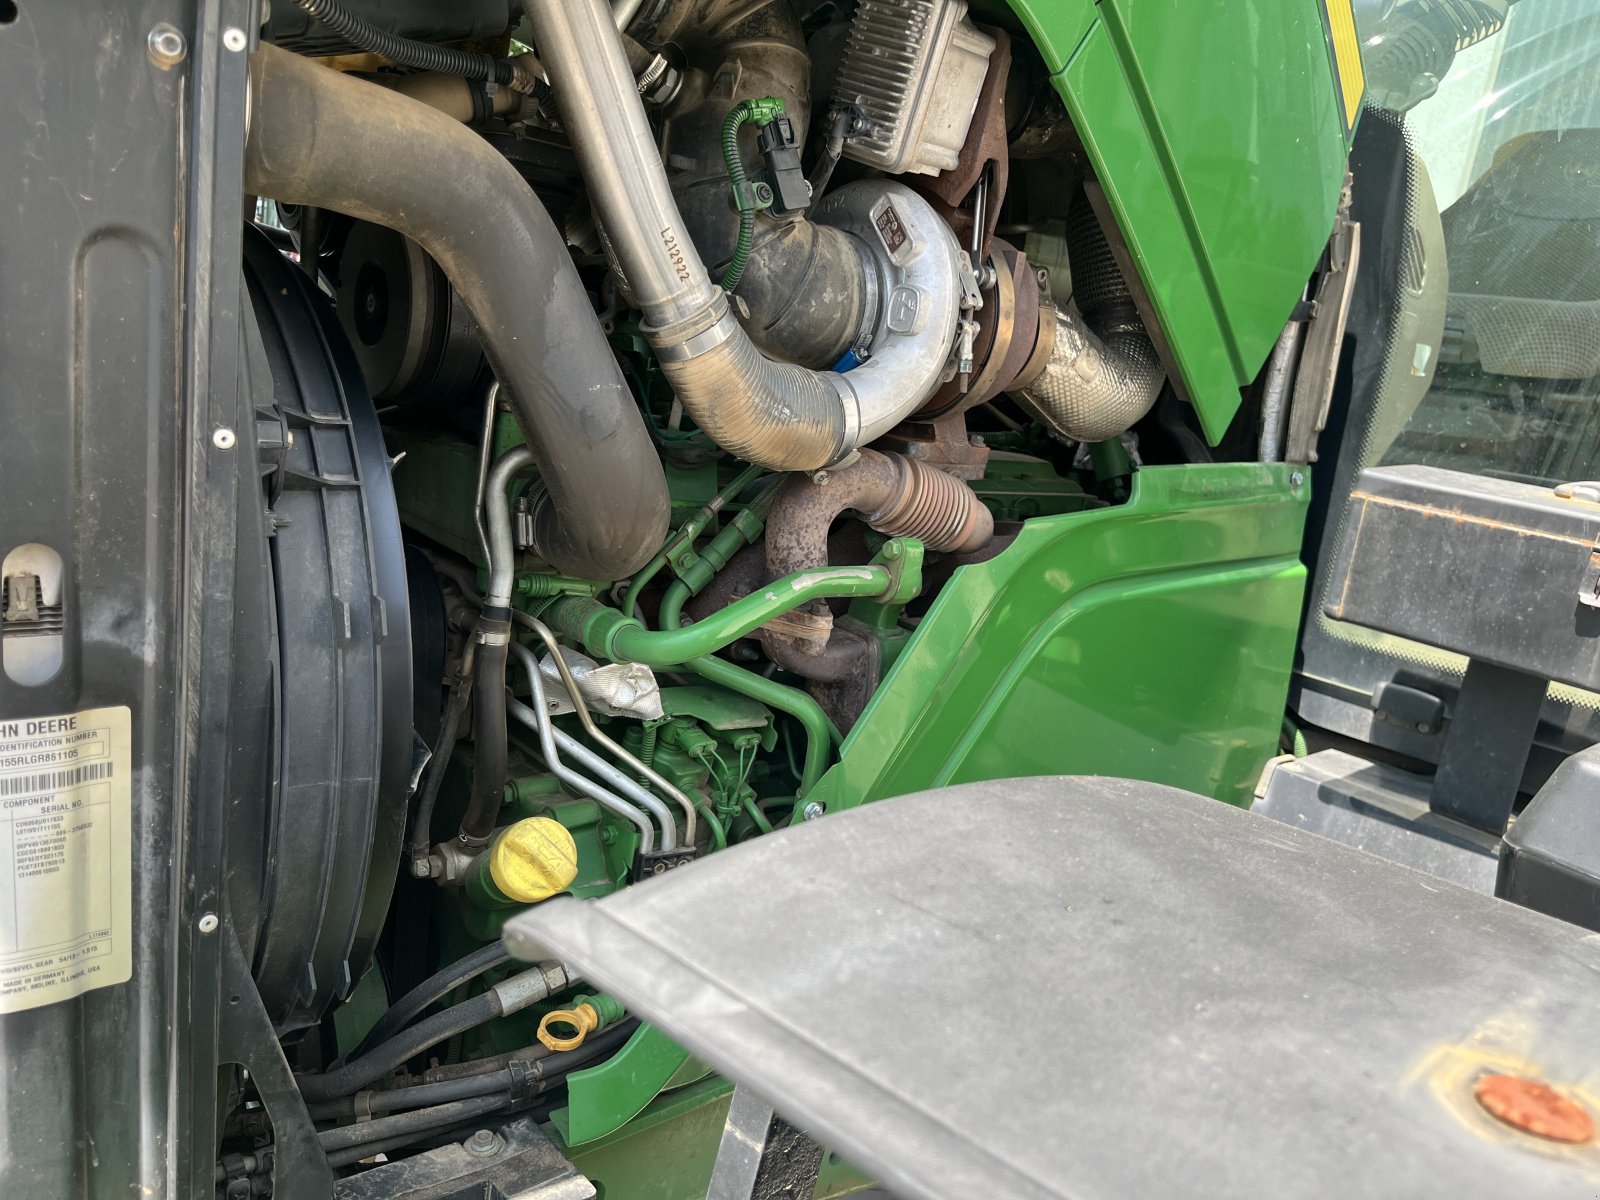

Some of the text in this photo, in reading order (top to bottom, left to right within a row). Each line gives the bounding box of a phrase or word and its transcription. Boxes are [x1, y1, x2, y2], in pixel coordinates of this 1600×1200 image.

[660, 226, 690, 282] L212922
[26, 716, 77, 736] DEERE
[65, 730, 98, 744] NUMBER
[3, 795, 56, 809] COMPONENT
[40, 803, 70, 815] SERIAL
[35, 959, 54, 969] GEAR
[87, 964, 101, 974] USA
[3, 970, 66, 988] MADE IN GERMANY
